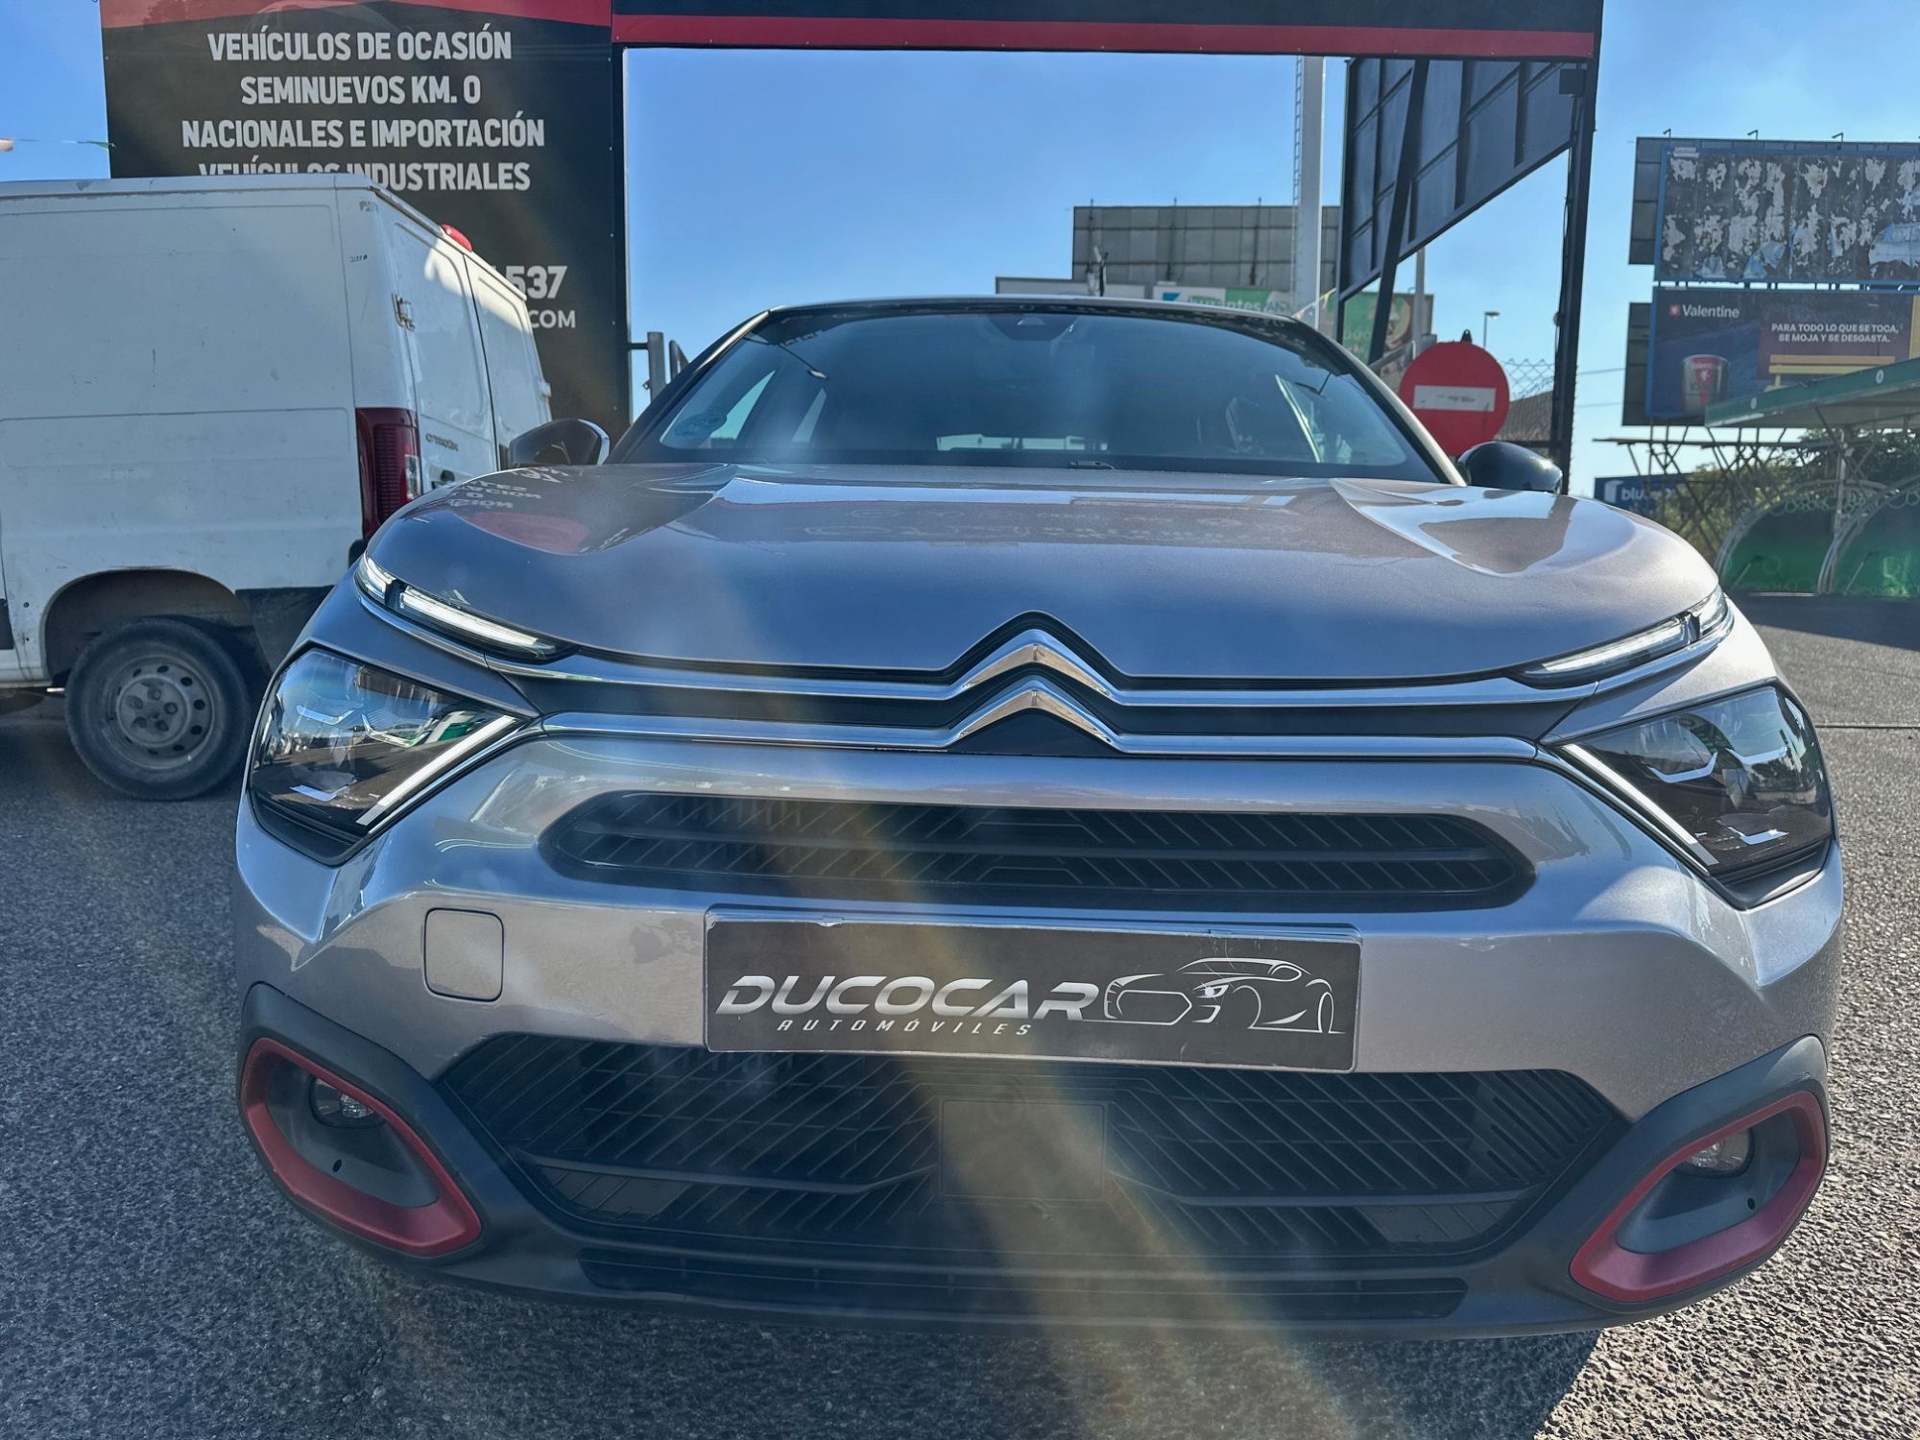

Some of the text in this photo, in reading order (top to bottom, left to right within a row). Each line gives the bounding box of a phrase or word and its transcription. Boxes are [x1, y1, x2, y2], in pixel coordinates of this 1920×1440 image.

[207, 23, 512, 61] VEHÍCULOS DE OCASIÓN
[241, 76, 405, 104] SEMINUEVOS
[412, 76, 457, 104] KM.
[182, 110, 544, 148] NACIONALES E IMPORTACIÓN
[1682, 304, 1740, 318] Valentine
[1771, 323, 1796, 333] PARA
[1798, 323, 1823, 333] TODO
[1825, 323, 1837, 333] LO
[1839, 324, 1858, 334] QUE
[1858, 324, 1870, 333] SE
[1778, 333, 1790, 343] SE
[1791, 333, 1819, 343] MOJA
[1820, 333, 1827, 343] Y
[1828, 333, 1840, 343] SE
[715, 975, 1100, 1021] DUCOCAR
[776, 1018, 1032, 1037] AUTOMÓVILES
